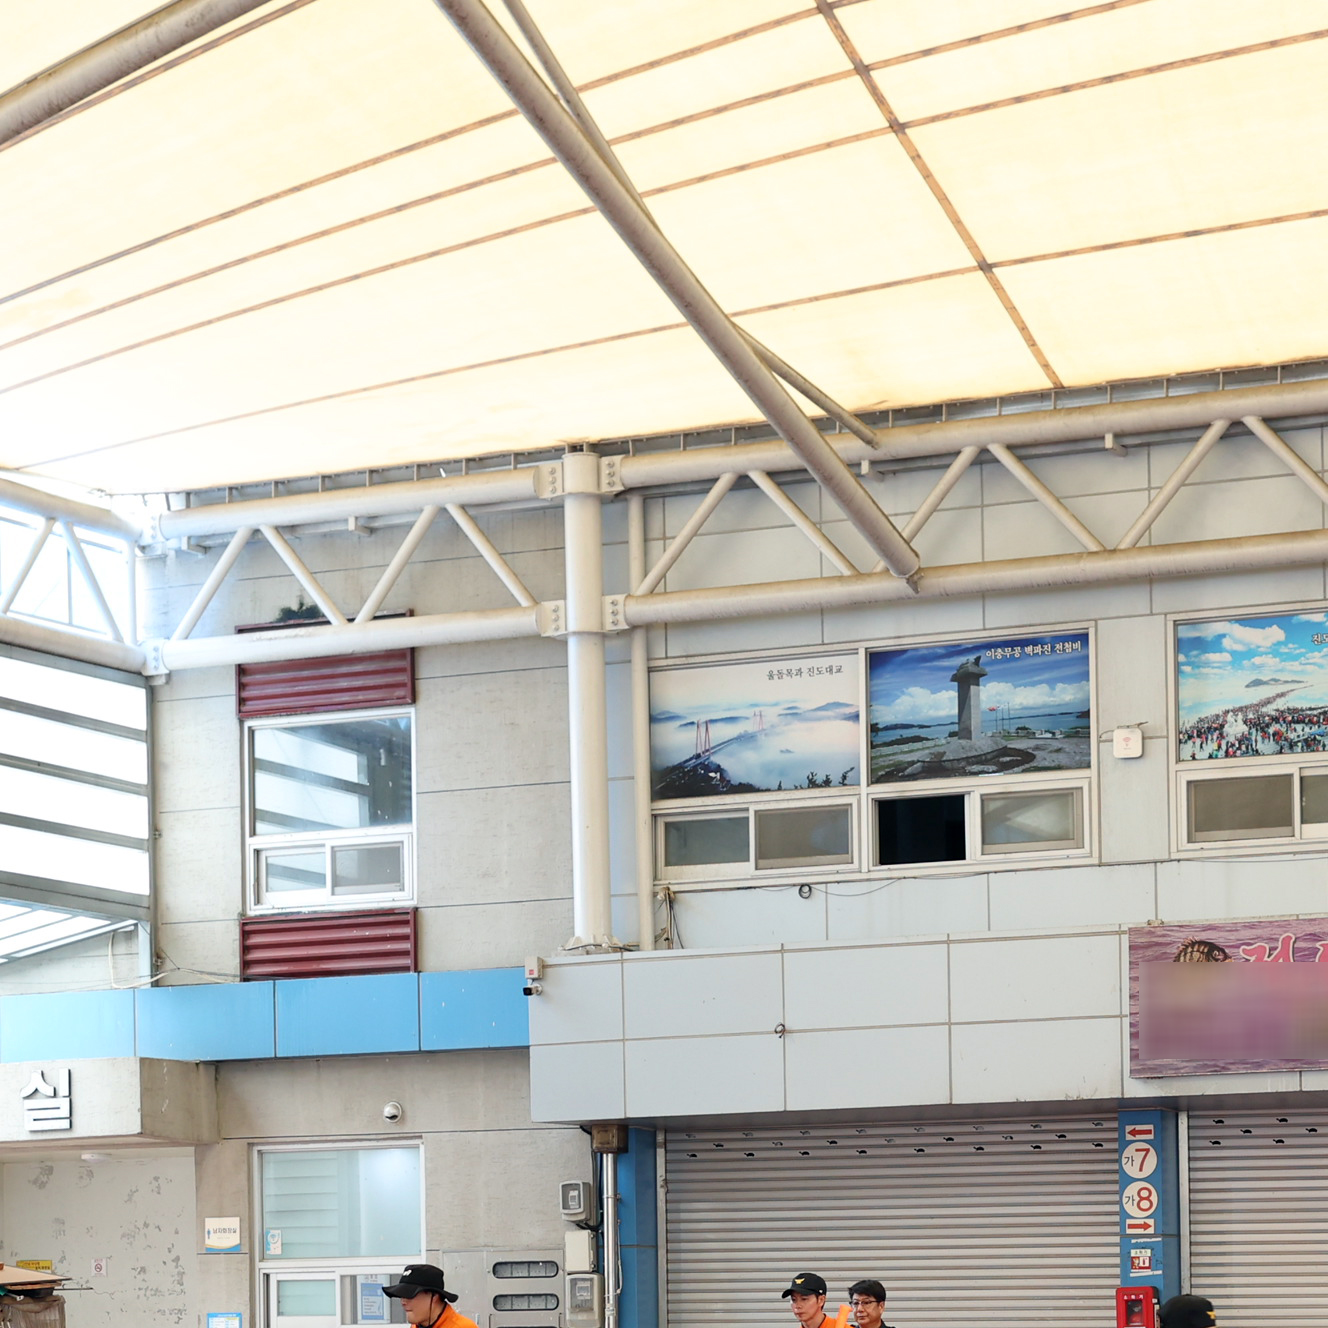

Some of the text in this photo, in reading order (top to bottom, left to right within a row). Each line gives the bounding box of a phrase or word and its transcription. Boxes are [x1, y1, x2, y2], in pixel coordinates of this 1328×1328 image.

[985, 640, 1082, 661] 이충무공 벽파진 전첩비
[806, 664, 844, 678] 진도대교
[20, 1067, 72, 1132] 실
